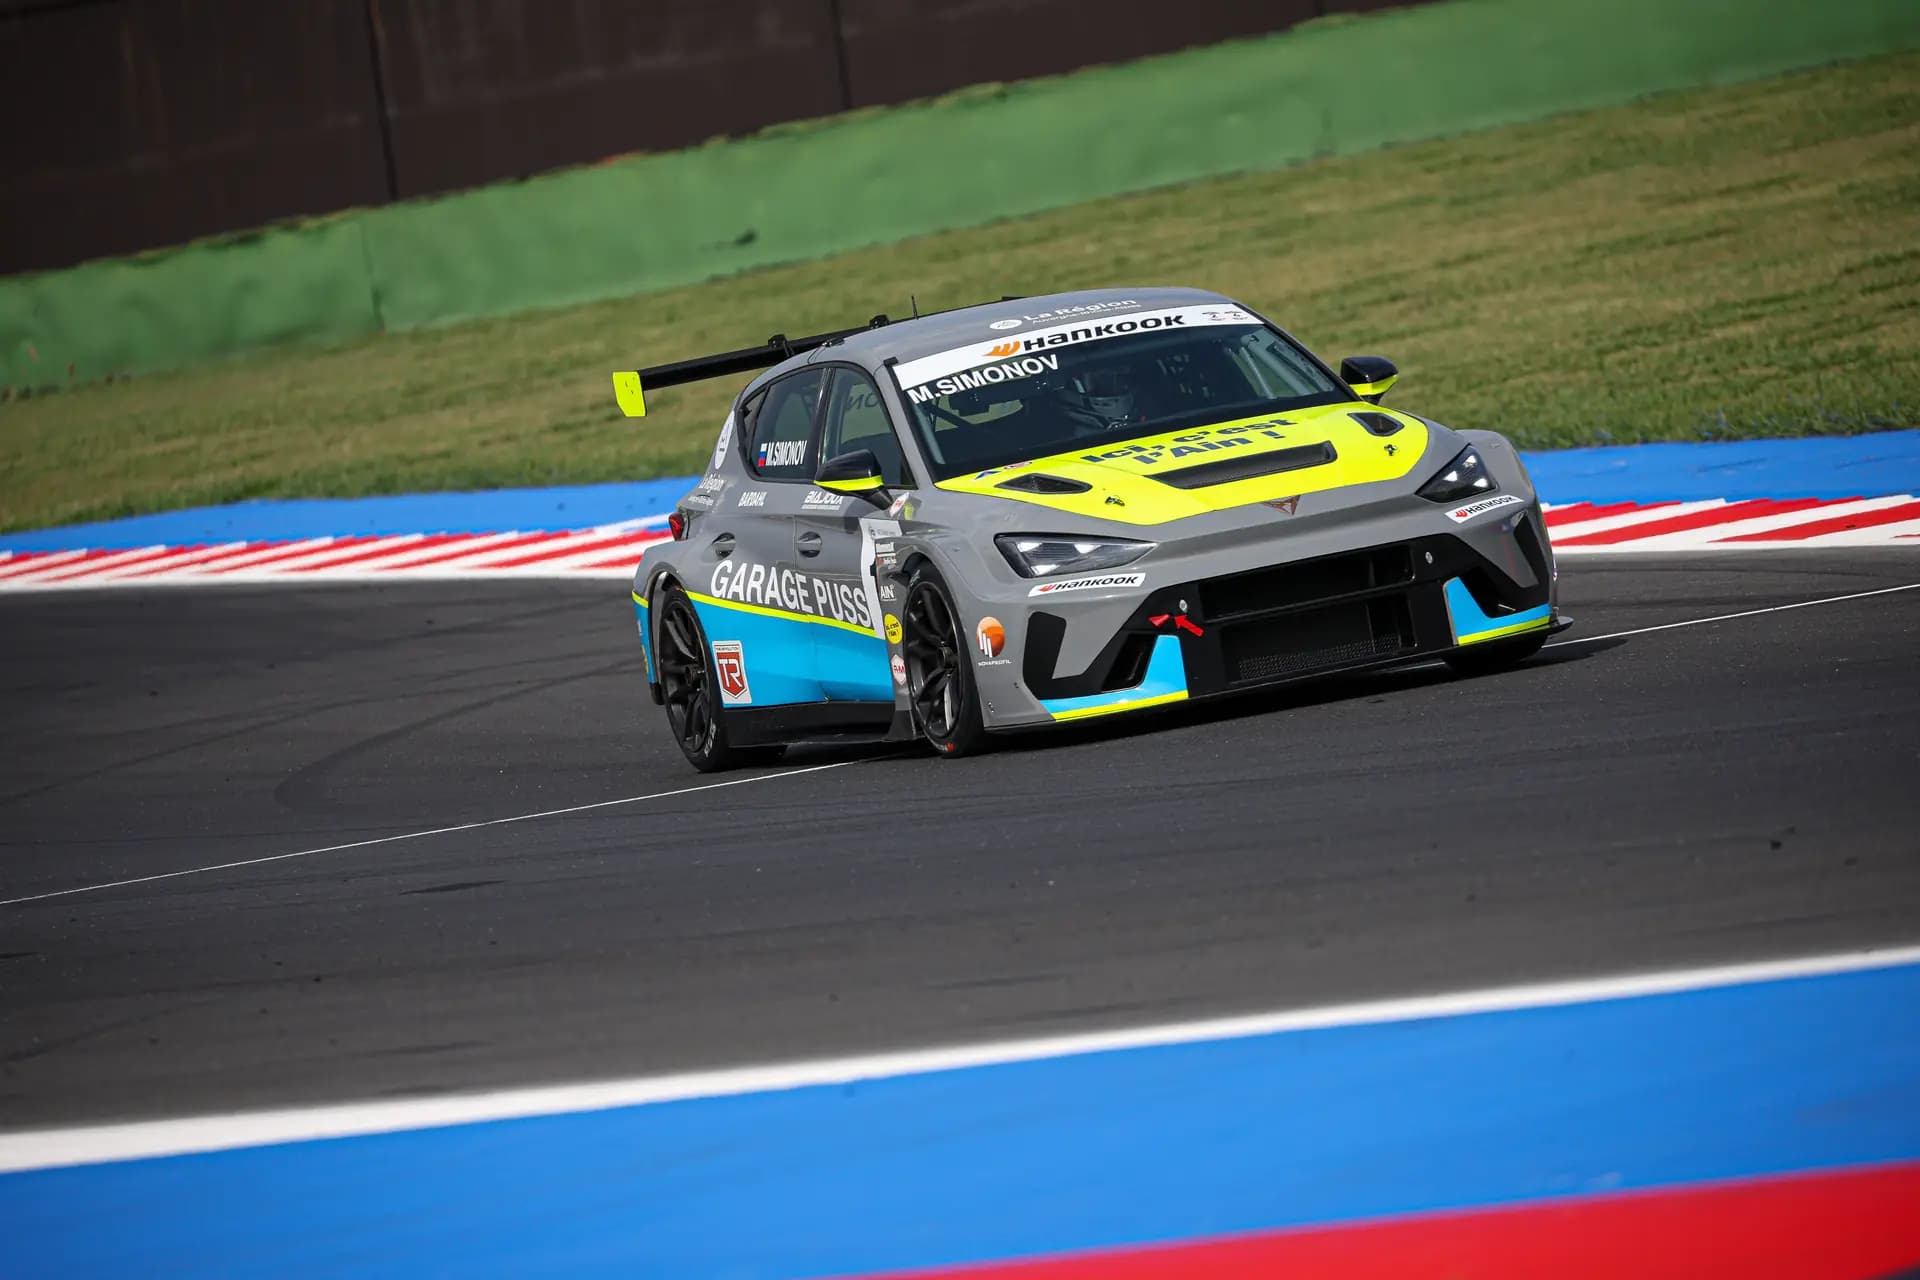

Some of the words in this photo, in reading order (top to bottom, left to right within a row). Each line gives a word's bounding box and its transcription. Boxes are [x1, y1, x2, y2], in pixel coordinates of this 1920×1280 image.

[903, 353, 1060, 405] M.SIMONOV
[1173, 419, 1299, 443] c'est
[765, 440, 809, 467] M.SIMONOV
[710, 559, 814, 614] GARAGE
[718, 658, 744, 688] TR
